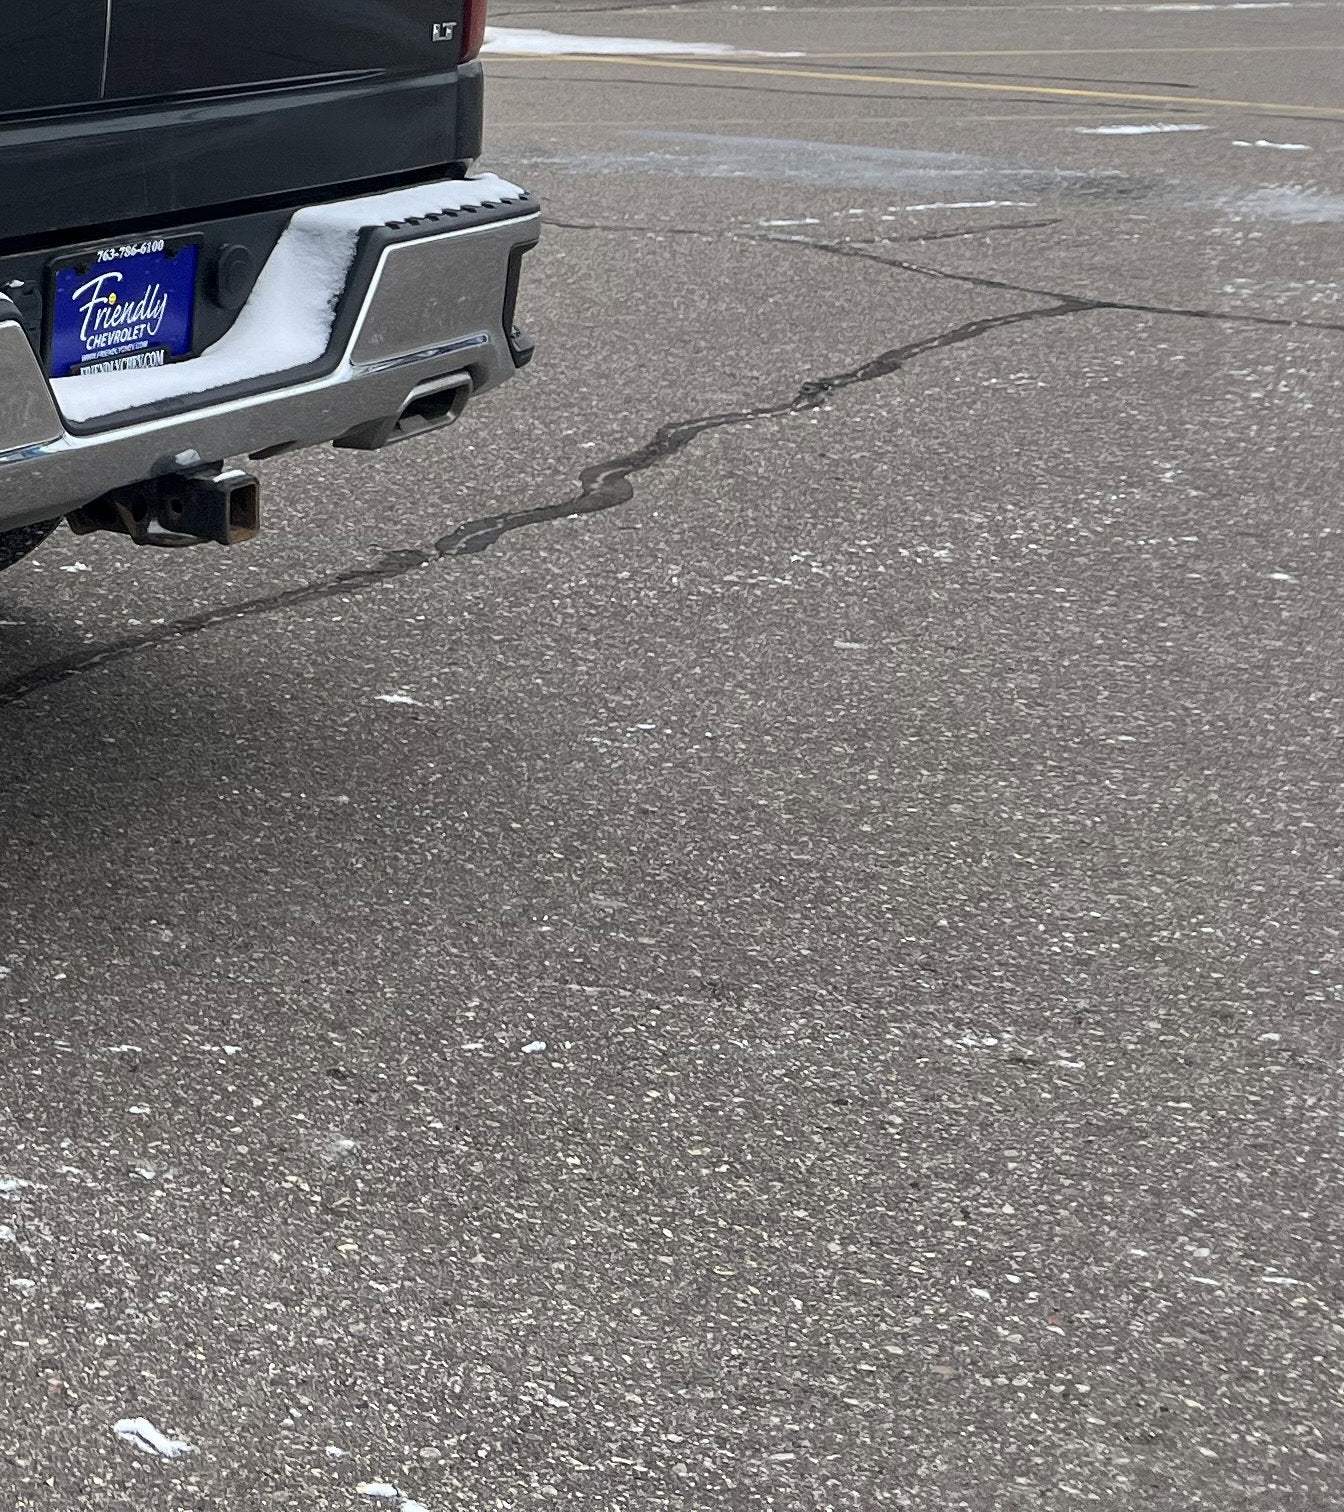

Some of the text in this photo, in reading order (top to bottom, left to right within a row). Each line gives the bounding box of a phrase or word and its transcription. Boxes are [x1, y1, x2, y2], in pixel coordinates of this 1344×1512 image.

[432, 21, 457, 42] LT
[97, 240, 164, 262] 763-786-6100
[73, 272, 167, 341] Friendly
[86, 324, 145, 350] CHEVROLET
